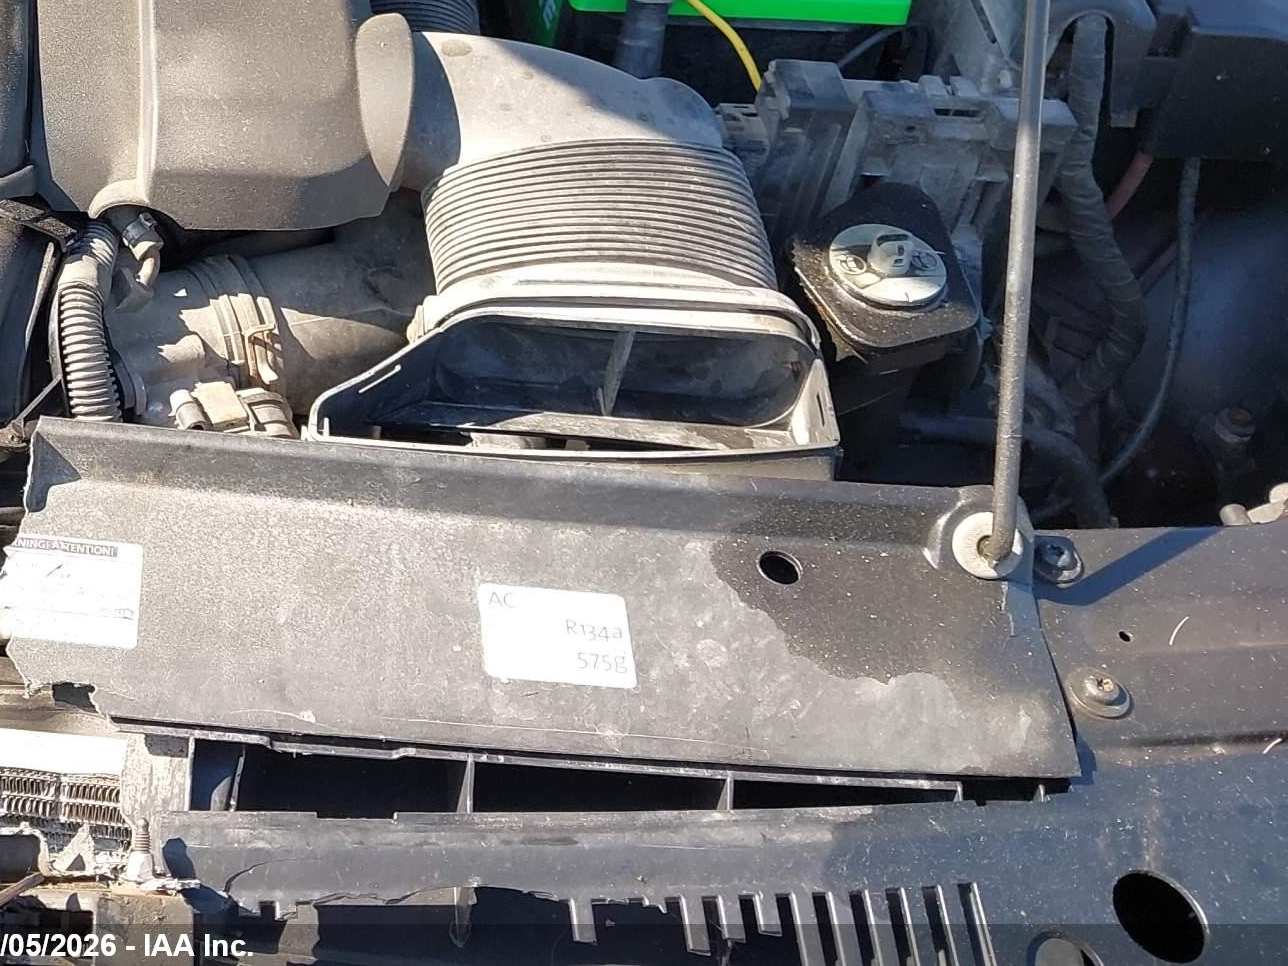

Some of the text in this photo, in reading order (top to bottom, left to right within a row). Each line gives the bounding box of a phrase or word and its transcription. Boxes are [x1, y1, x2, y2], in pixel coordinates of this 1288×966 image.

[489, 591, 516, 608] AC
[566, 619, 623, 642] R134a
[577, 652, 628, 674] 575g
